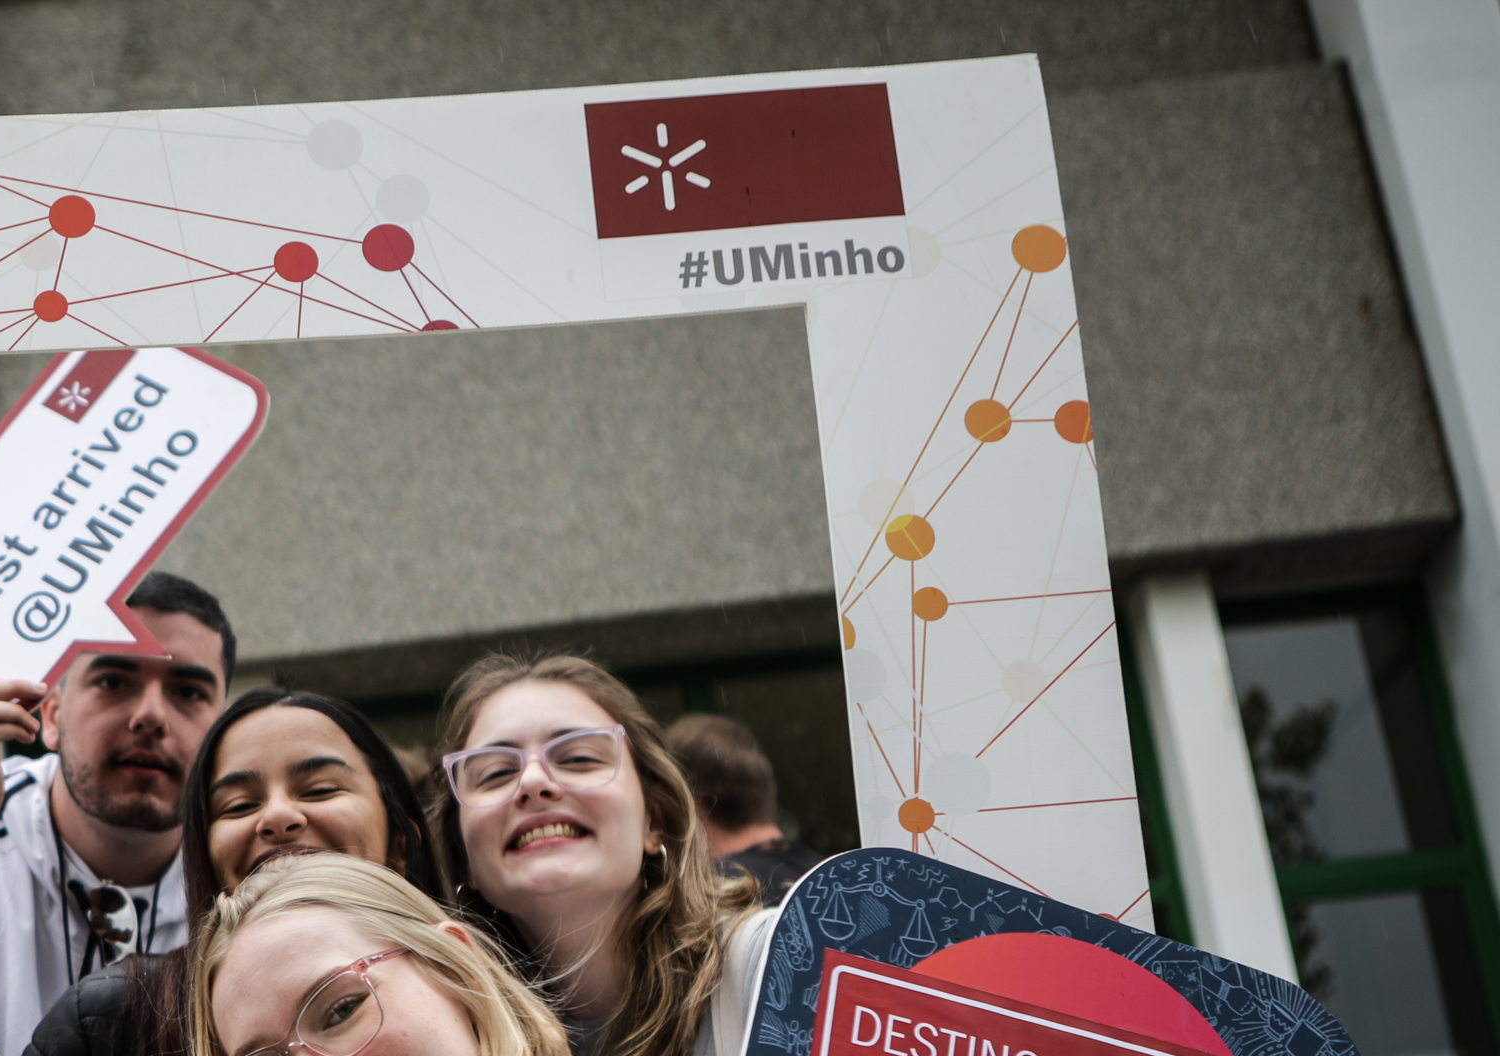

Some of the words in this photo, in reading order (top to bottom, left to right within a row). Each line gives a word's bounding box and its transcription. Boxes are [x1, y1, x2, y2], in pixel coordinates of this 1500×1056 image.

[678, 239, 906, 290] #UMinho
[32, 373, 171, 531] arrived
[12, 429, 200, 643] @UMinho
